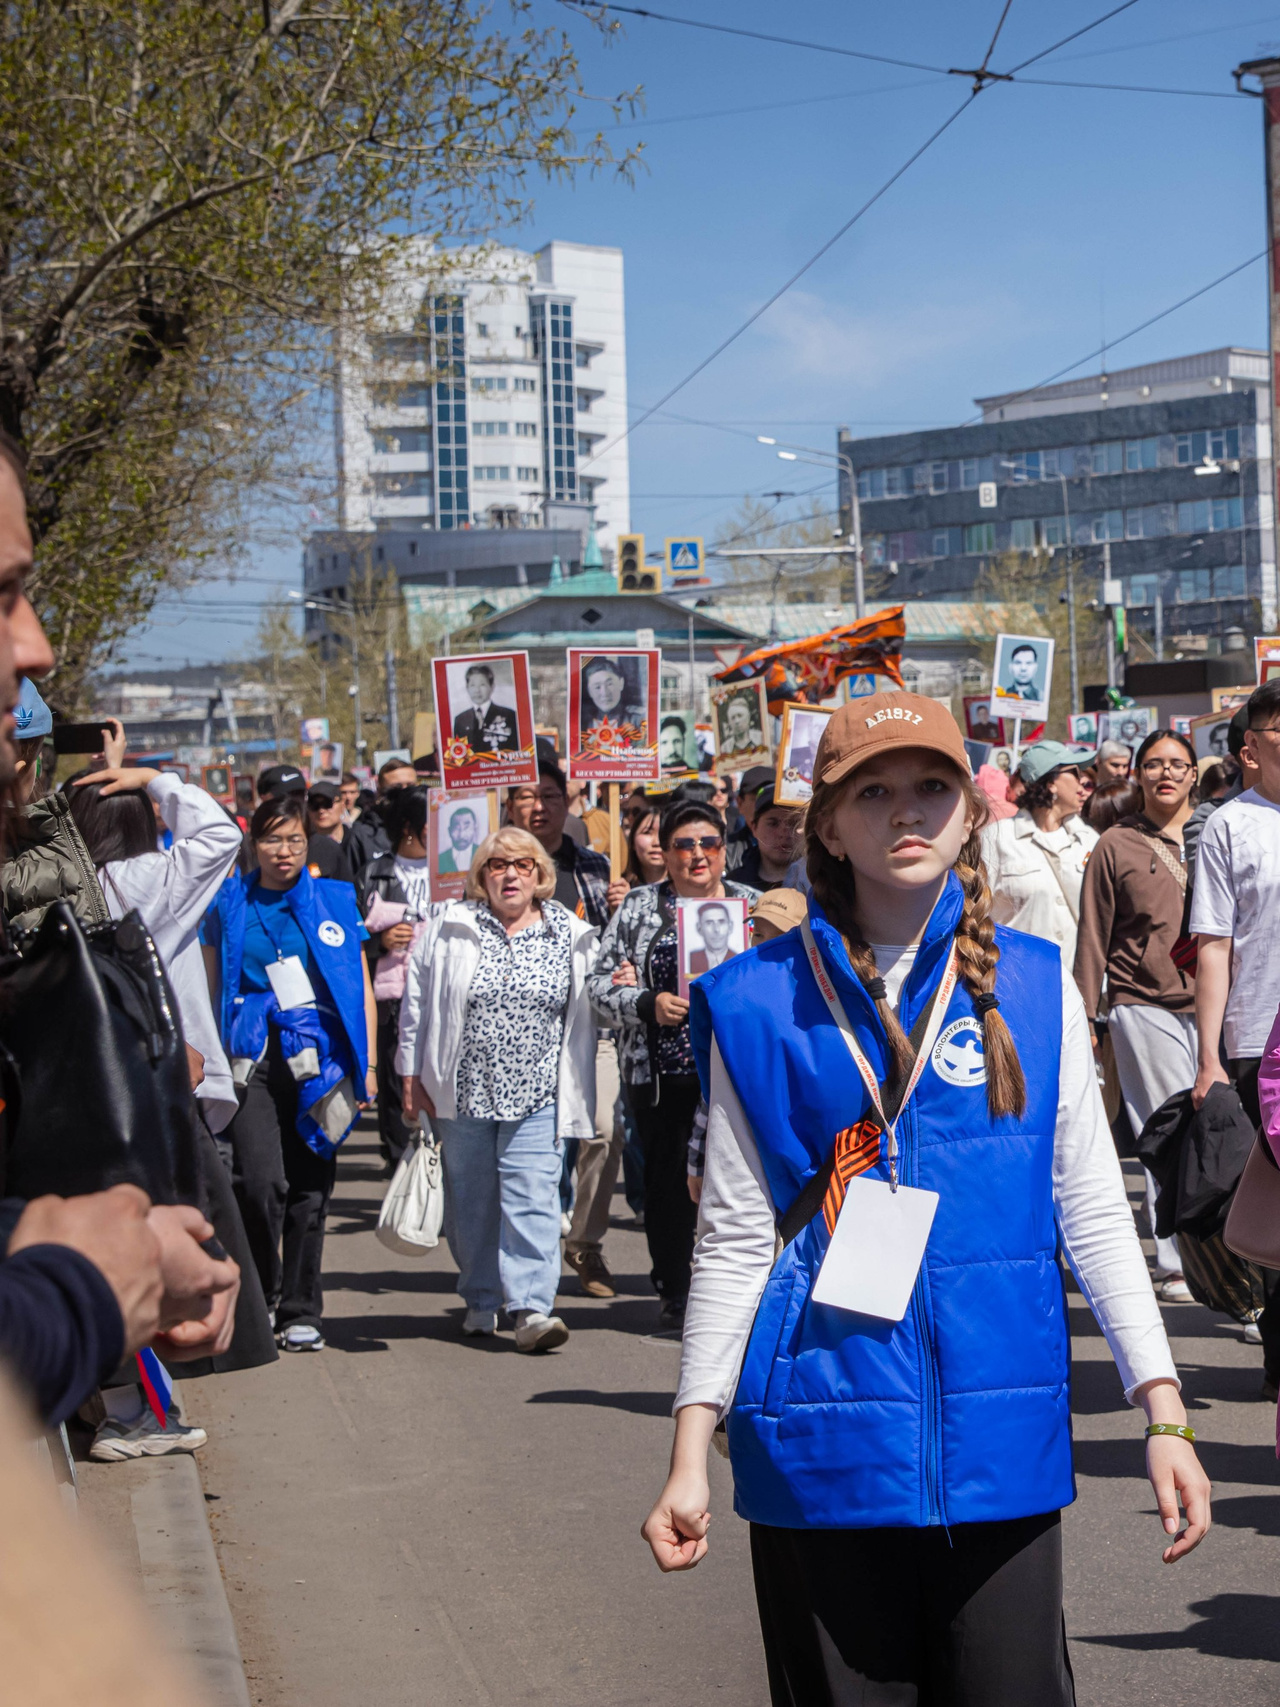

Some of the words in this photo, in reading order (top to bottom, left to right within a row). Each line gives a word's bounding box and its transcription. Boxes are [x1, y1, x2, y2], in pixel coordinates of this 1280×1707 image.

[940, 973, 954, 1005] ГОРДИМСЯ
[935, 1020, 971, 1060] ВОЛОНТЕРЫ
[973, 1021, 985, 1031] ПО
[857, 1054, 876, 1088] ГОРДИМСЯ
